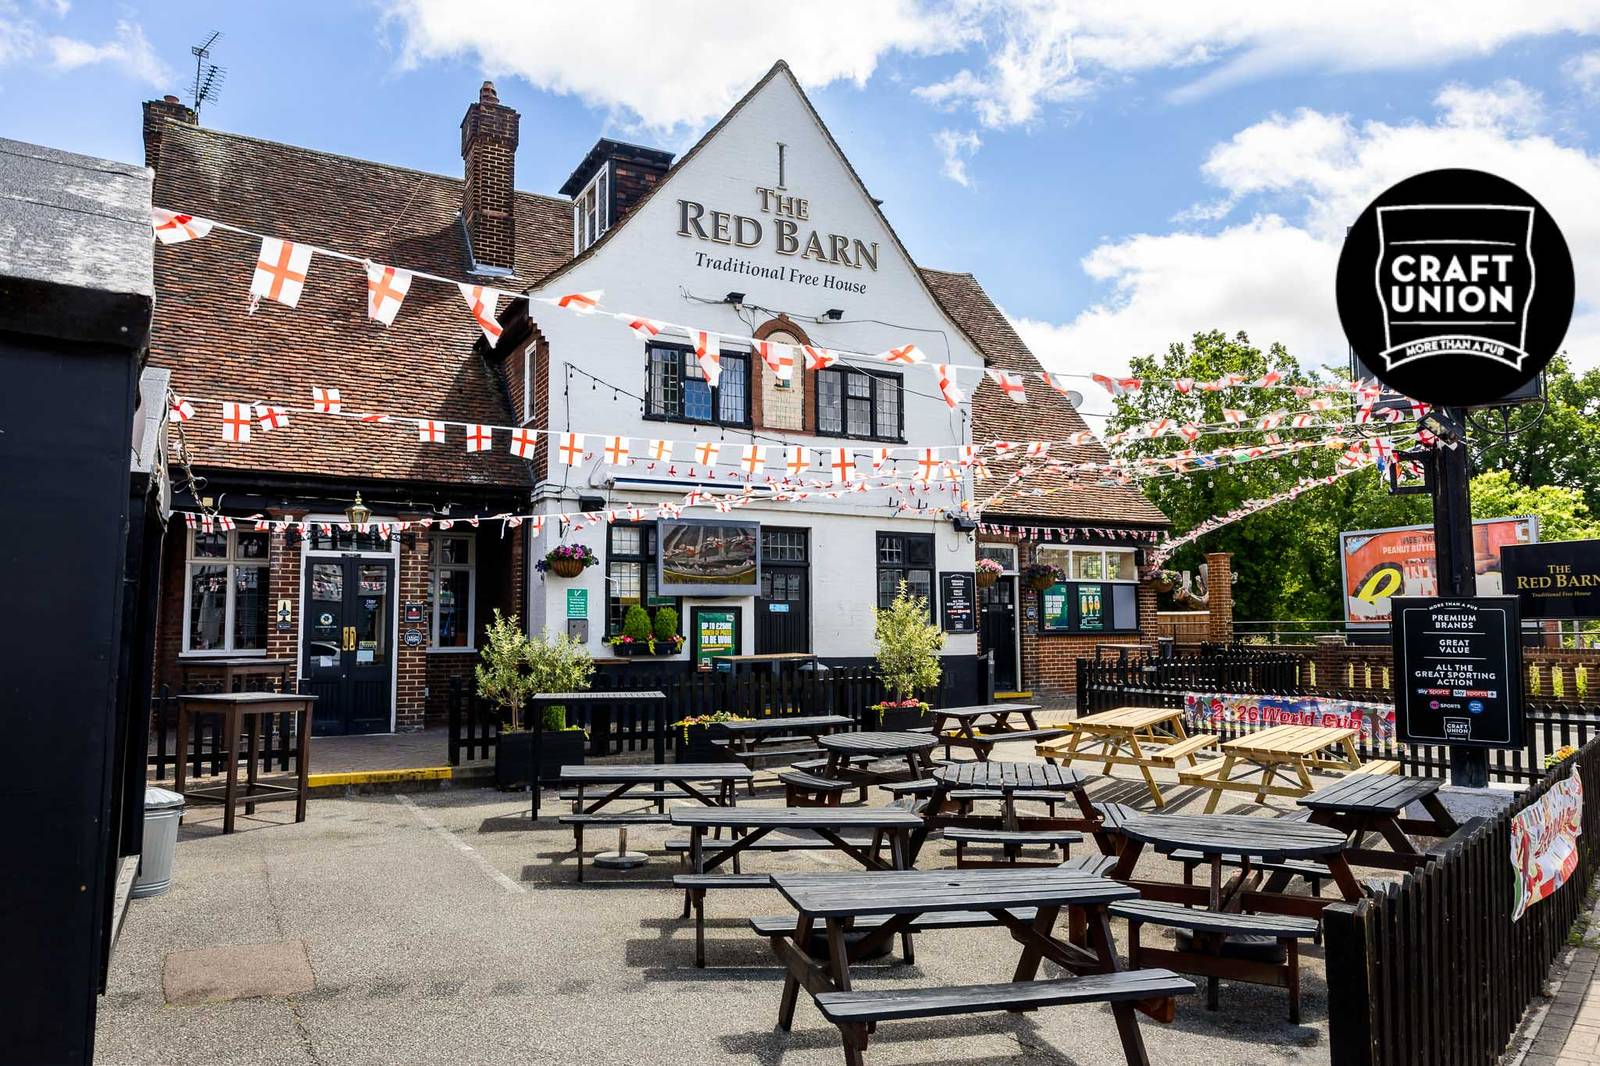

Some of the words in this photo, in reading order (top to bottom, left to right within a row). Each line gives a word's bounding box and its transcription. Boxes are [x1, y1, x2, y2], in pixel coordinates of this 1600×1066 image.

[756, 187, 810, 221] THE
[677, 199, 763, 248] RED
[774, 218, 880, 272] BARN
[695, 252, 785, 281] Traditional
[789, 268, 819, 286] Free
[823, 275, 867, 294] House
[1383, 545, 1410, 555] PEANUT
[1547, 564, 1572, 574] THE
[1517, 576, 1552, 589] RED
[1555, 574, 1600, 588] BARN
[1429, 602, 1444, 610] MORE
[1415, 670, 1444, 678] GREAT
[1447, 672, 1496, 680] SPORTING
[1263, 706, 1315, 726] World
[1321, 712, 1362, 731] Cup
